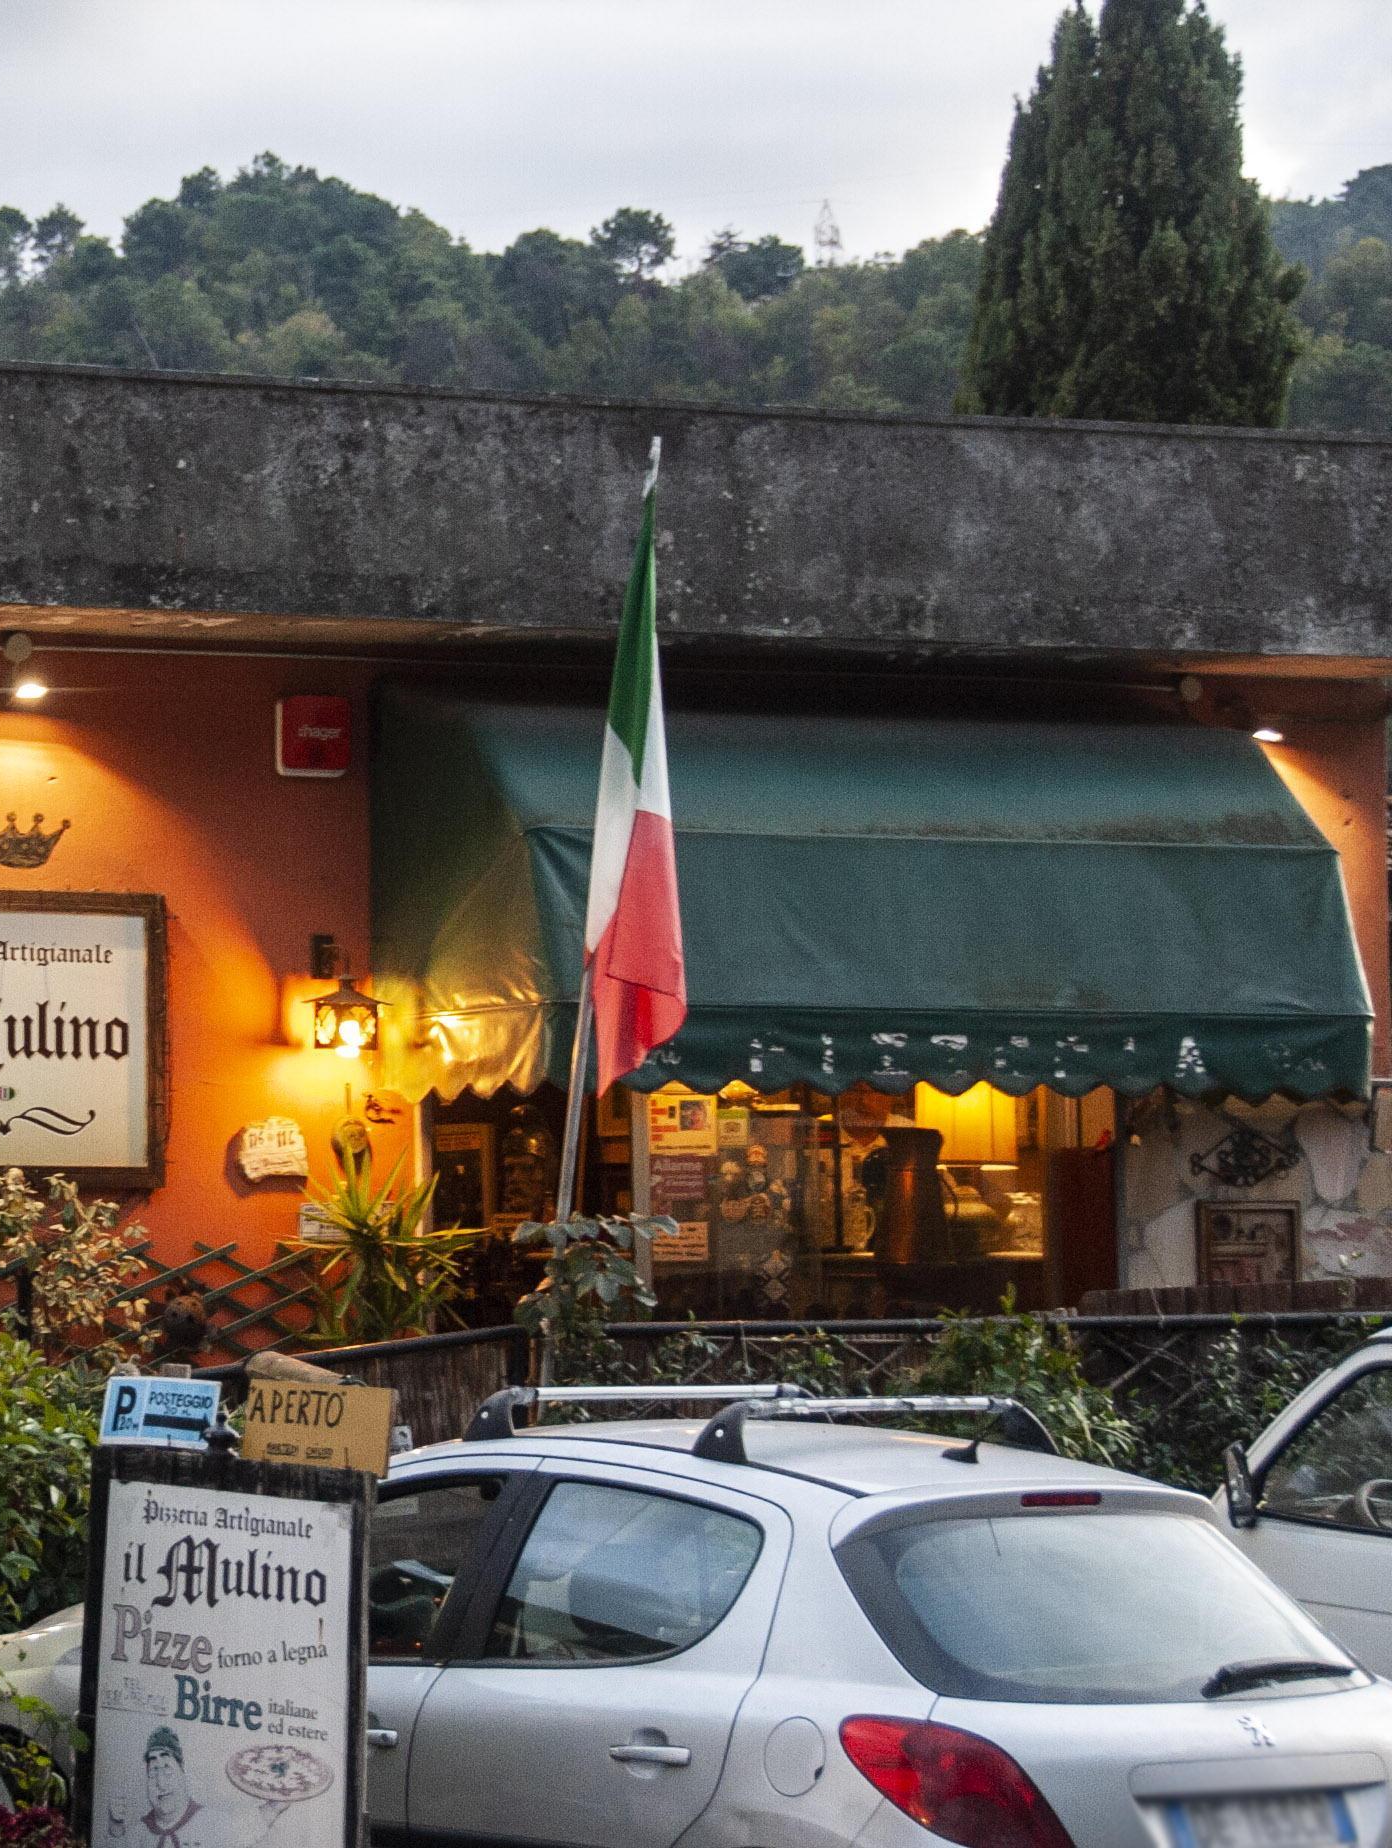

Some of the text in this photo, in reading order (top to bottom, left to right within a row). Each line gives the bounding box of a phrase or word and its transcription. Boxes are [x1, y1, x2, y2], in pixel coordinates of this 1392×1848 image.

[111, 1385, 137, 1431] P
[148, 1391, 213, 1409] POSTEGGIO
[142, 1499, 314, 1538] Pizzeria Artigianale
[124, 1535, 327, 1608] il Mulino
[110, 1603, 213, 1674] Pizze
[268, 1649, 278, 1663] a
[282, 1640, 329, 1665] legna
[174, 1674, 263, 1731] Birre
[268, 1699, 318, 1720] italiane
[268, 1718, 329, 1741] ed estere
